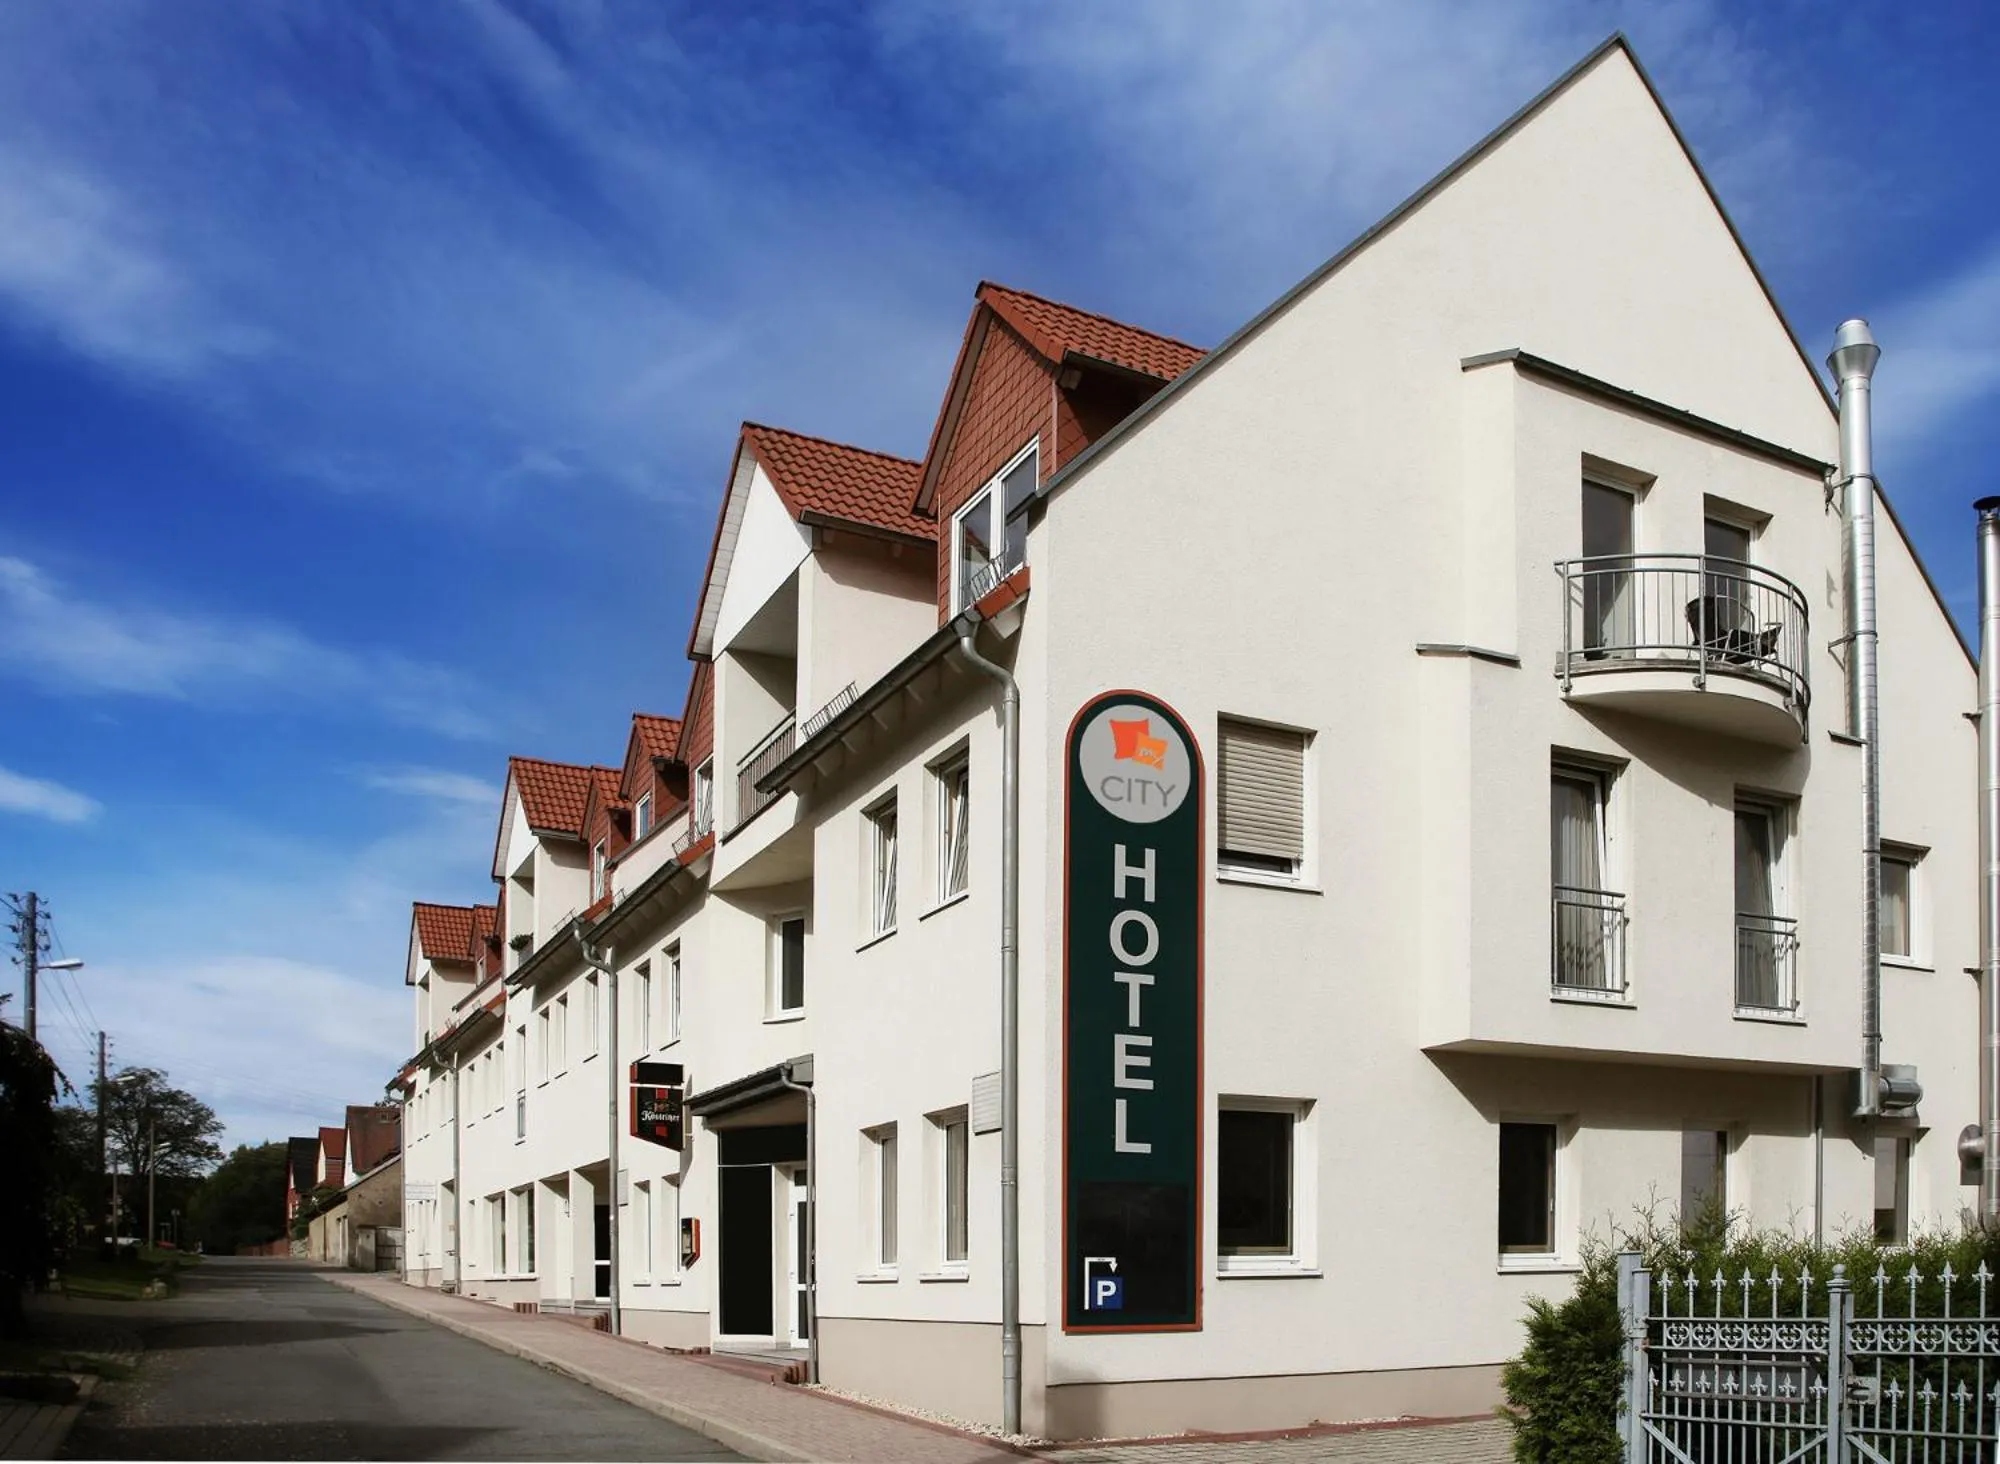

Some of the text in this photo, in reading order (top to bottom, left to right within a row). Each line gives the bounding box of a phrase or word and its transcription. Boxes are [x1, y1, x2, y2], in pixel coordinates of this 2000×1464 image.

[1100, 775, 1176, 808] CITY
[1109, 843, 1160, 1154] HOTEL
[1096, 1280, 1117, 1306] P
